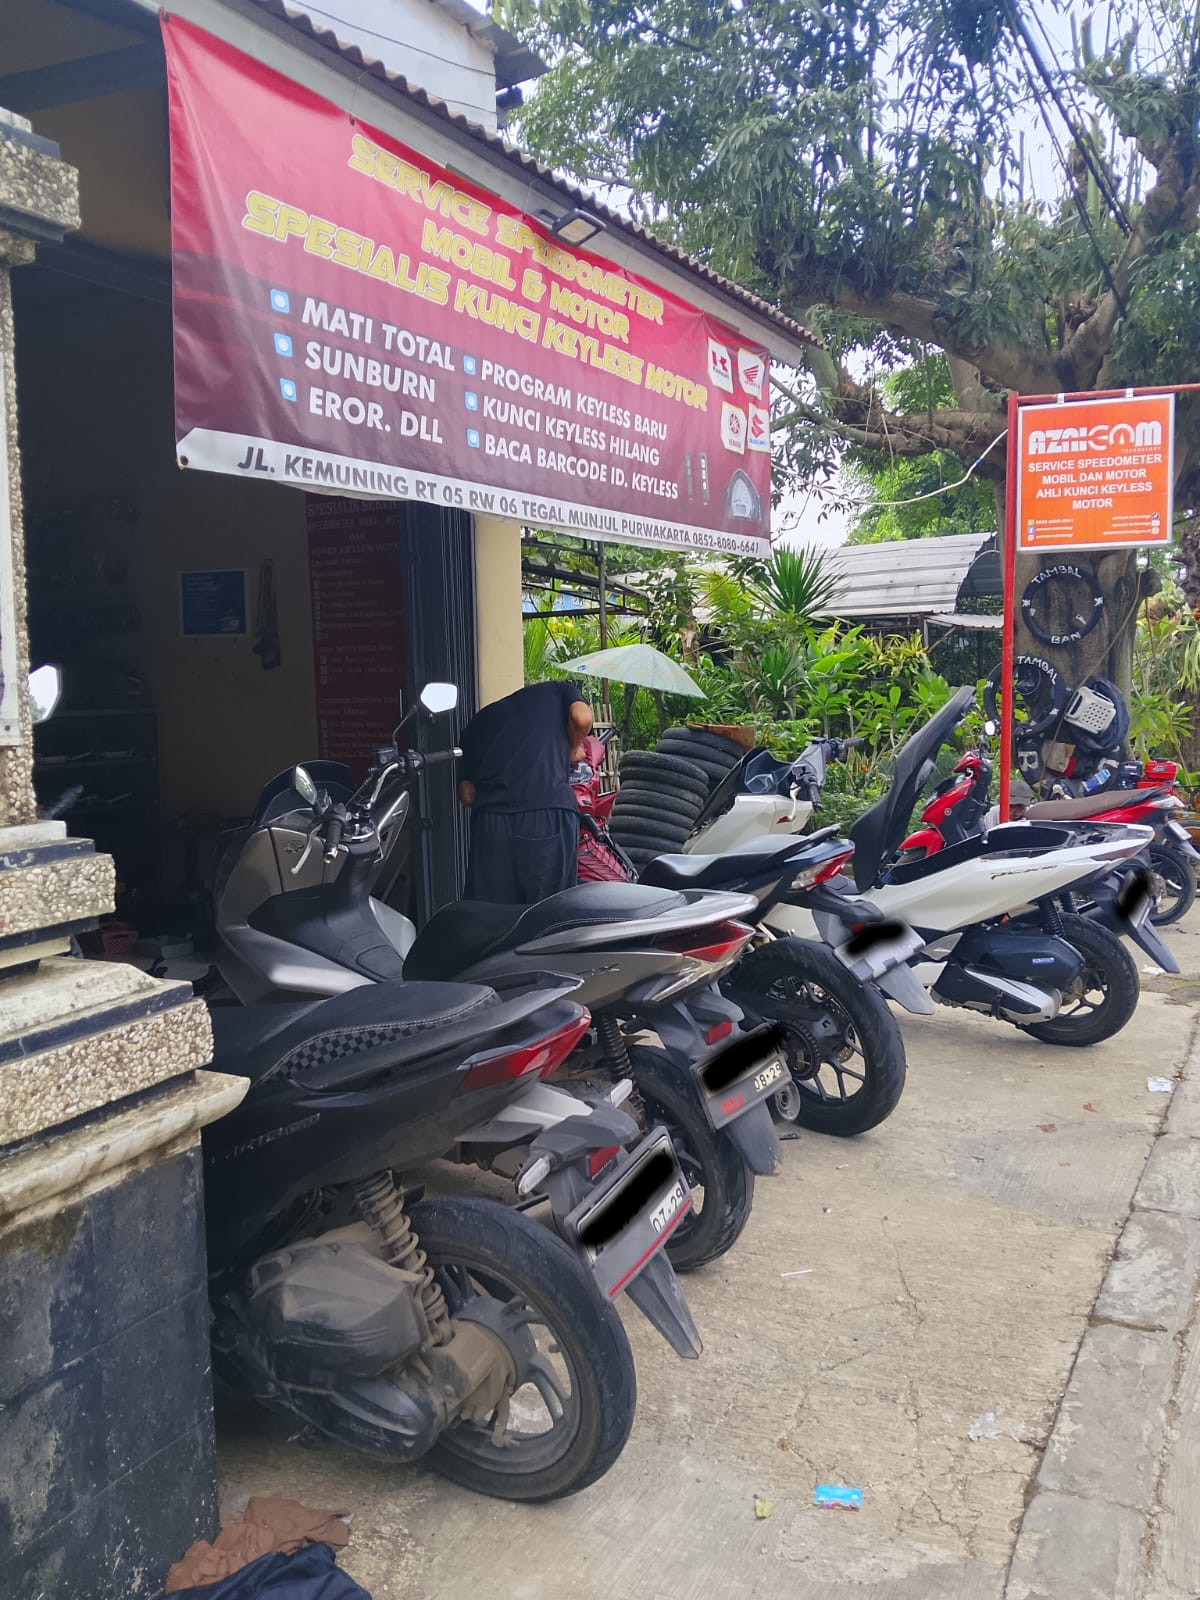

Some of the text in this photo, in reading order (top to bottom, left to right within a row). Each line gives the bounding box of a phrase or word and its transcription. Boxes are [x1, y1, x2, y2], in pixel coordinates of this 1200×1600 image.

[349, 133, 664, 325] SERVICE SPEEDOMETER
[242, 190, 708, 412] SPESIALIS KUNCI KEYLESS MOTOR
[421, 218, 630, 344] MOBIL & MOTOR
[302, 297, 455, 372] MATI TOTAL
[304, 342, 436, 403] SUNBURN
[481, 359, 667, 441] PROGRAM KEYLESS BARU
[309, 387, 443, 444] EROR. DLL
[483, 396, 660, 466] KUNCI KEYLESS HILANG
[485, 433, 679, 500] BACA BARCODE ID. KEYLESS
[1028, 453, 1162, 473] SERVICE SPEEDOMETER
[1036, 481, 1153, 499] AHLI KUNCI KEYLESS
[1042, 469, 1146, 485] MOBIL DAN MOTOR
[237, 446, 275, 473] JL.
[285, 454, 409, 496] KEMUNING
[415, 479, 437, 499] RT
[443, 485, 464, 505] 05
[469, 490, 495, 511] RW
[500, 496, 518, 515] 06
[521, 500, 565, 523] TEGAL
[568, 509, 618, 532] MUNJUL
[621, 519, 690, 544] PURWAKARTA
[1073, 498, 1113, 510] MOTOR
[1031, 565, 1082, 584] TAMBAL
[1050, 631, 1081, 644] BAN
[1017, 655, 1058, 685] TAMBAL
